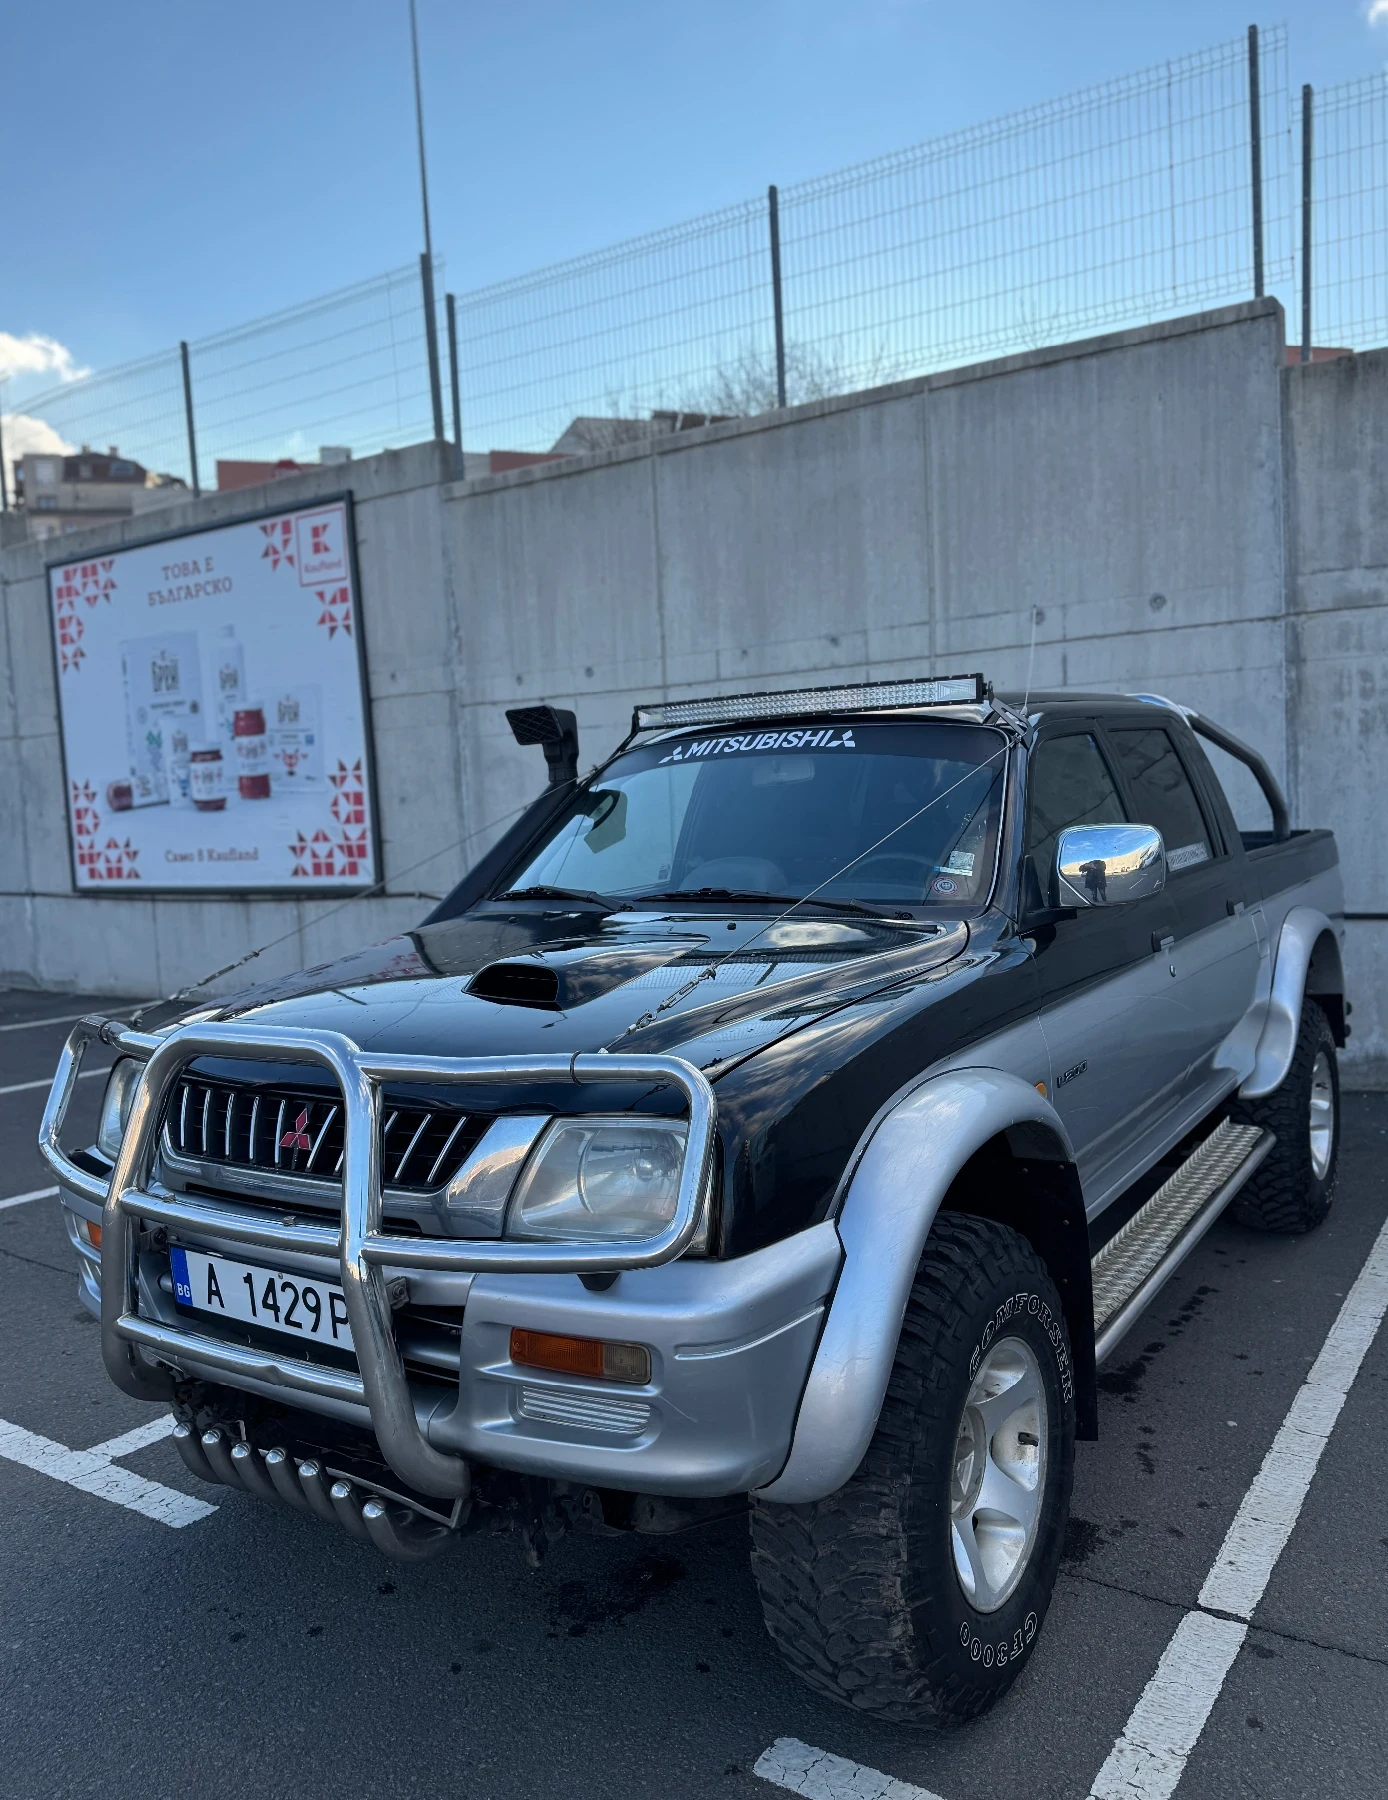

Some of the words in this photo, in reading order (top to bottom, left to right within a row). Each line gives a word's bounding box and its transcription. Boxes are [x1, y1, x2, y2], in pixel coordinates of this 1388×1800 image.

[161, 559, 201, 581] ТОВА
[204, 556, 214, 572] Е
[147, 576, 233, 607] БЪЛГАРСКО
[684, 729, 835, 758] MITSUBISHI
[164, 849, 194, 863] Само
[207, 846, 259, 862] Kaufland
[1057, 1060, 1087, 1088] L200
[176, 1282, 190, 1298] BG
[207, 1262, 225, 1308] A
[969, 1292, 1073, 1404] COMFORSER
[959, 1611, 1038, 1668] CF3000
